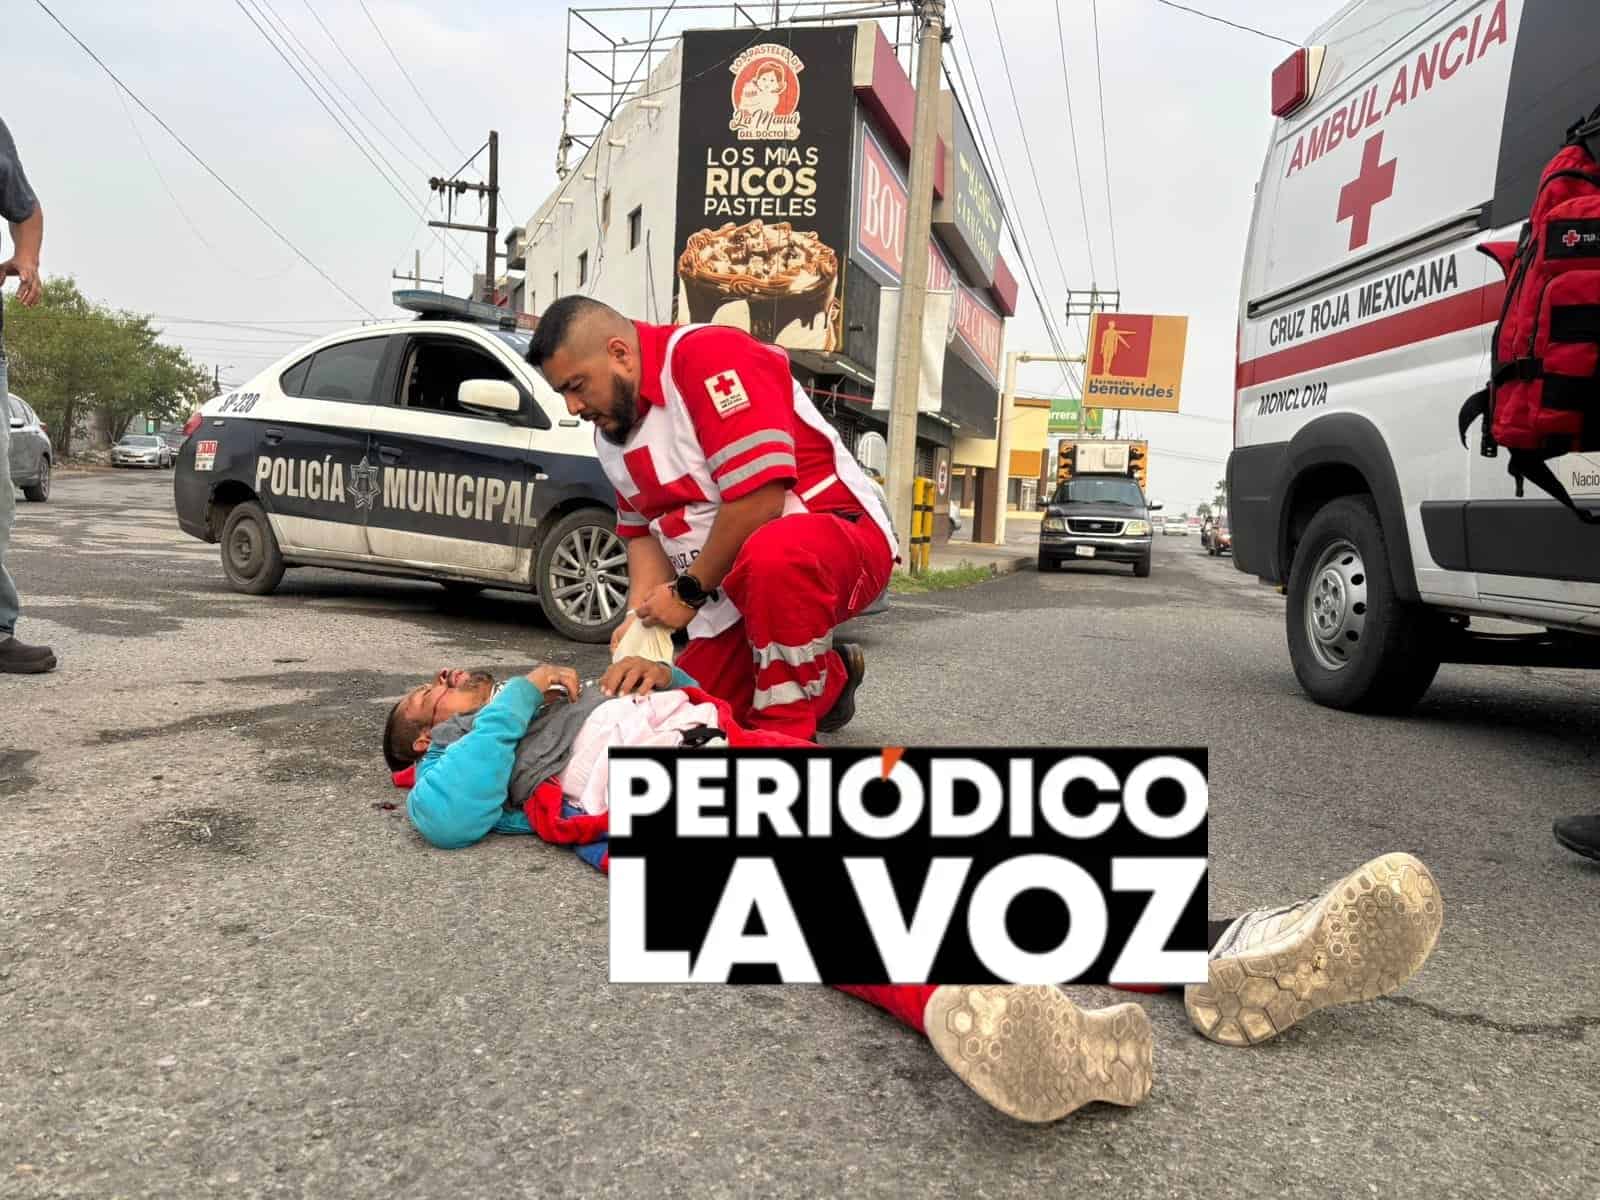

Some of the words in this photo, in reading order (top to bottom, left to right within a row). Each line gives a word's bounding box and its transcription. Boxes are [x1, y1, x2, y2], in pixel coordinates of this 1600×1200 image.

[1286, 0, 1508, 178] AMBULANCIA
[707, 147, 755, 166] LOS
[765, 147, 819, 166] MAS
[705, 167, 817, 196] RICOS
[704, 198, 817, 217] PASTELES
[1269, 308, 1306, 347] CRUZ
[1310, 293, 1350, 335] ROJA
[1357, 253, 1458, 319] MEXICANA
[1087, 380, 1175, 399] benavides
[1257, 381, 1329, 417] MONCLOVA
[255, 454, 346, 503] POLICÍA
[383, 466, 538, 528] MUNICIPAL
